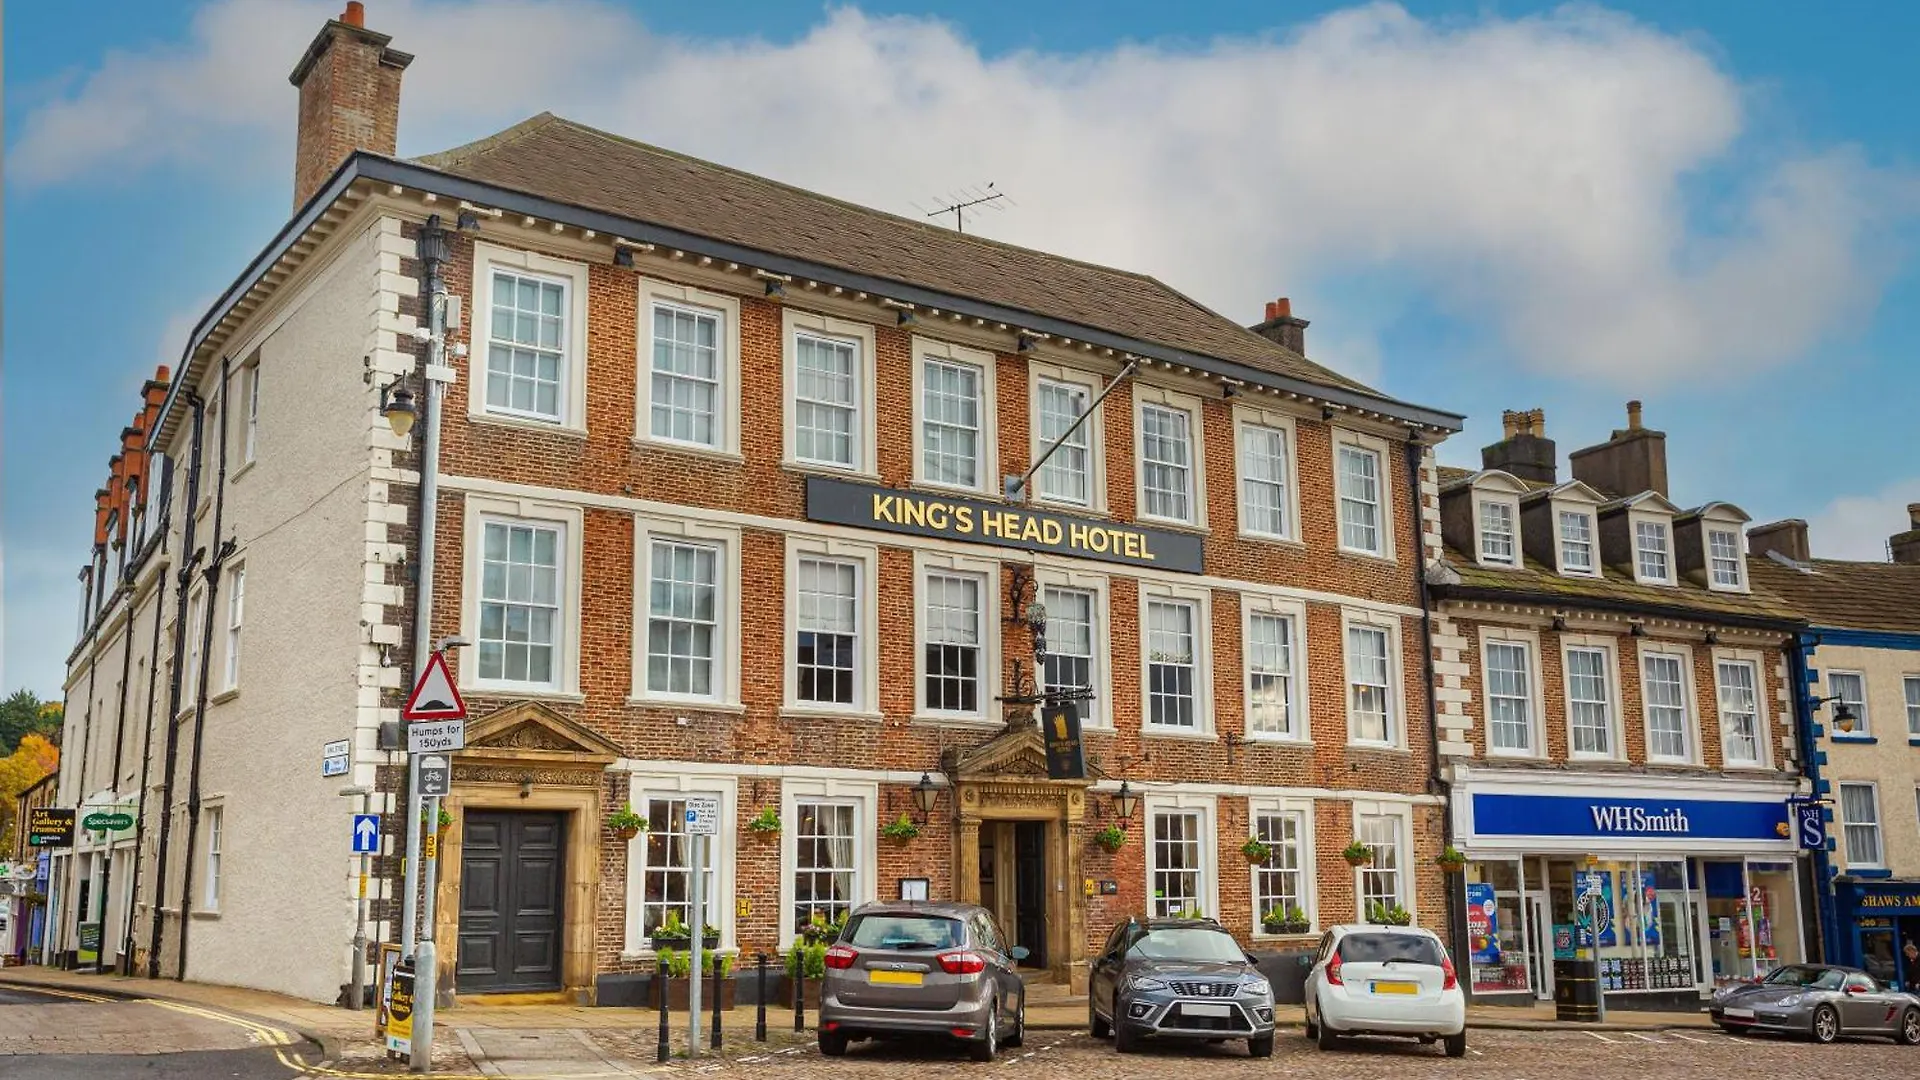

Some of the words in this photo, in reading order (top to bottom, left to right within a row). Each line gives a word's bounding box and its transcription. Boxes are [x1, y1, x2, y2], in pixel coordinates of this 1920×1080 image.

[873, 493, 974, 533] KING'S
[982, 510, 1063, 545] HEAD
[1069, 523, 1155, 560] HOTEL
[411, 726, 443, 737] Humps
[447, 725, 460, 734] for
[419, 739, 452, 748] 150yds
[33, 810, 48, 818] Art
[1590, 805, 1690, 832] WHSmith
[1802, 809, 1819, 818] WH
[32, 818, 62, 827] Gallery
[87, 817, 129, 826] Specsavers
[1804, 817, 1822, 846] S
[1862, 896, 1901, 907] SHAWS
